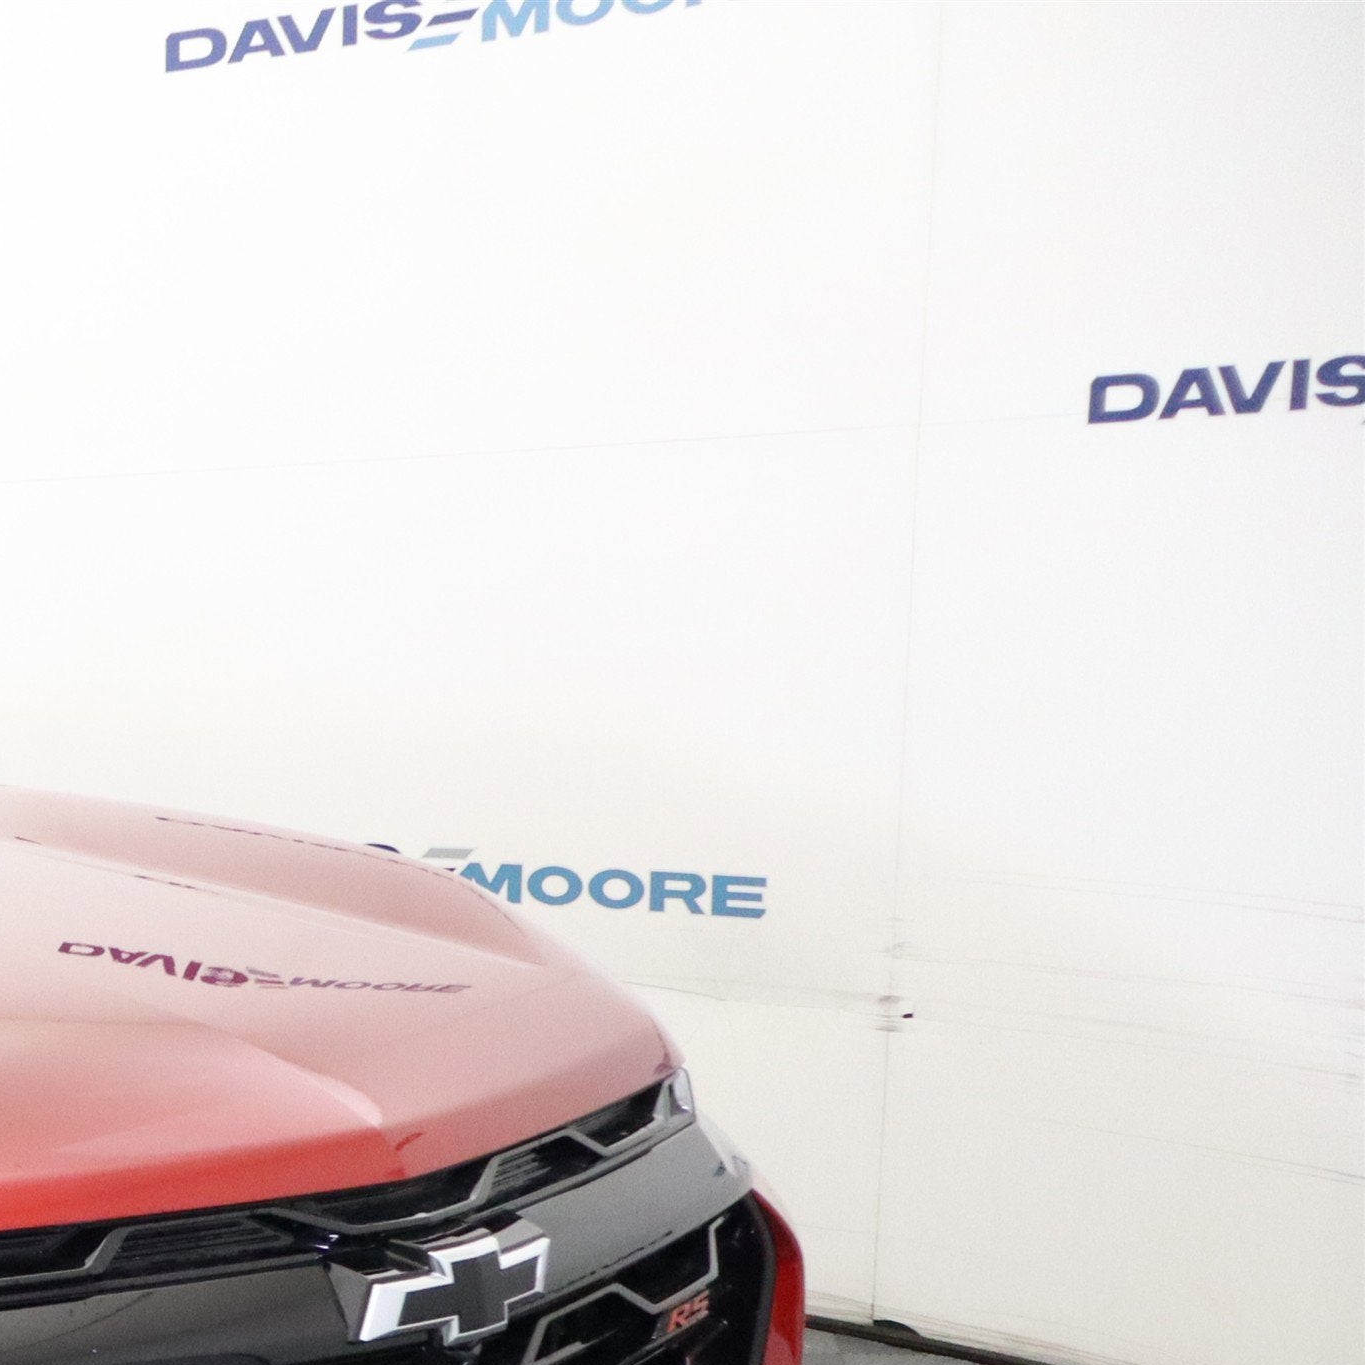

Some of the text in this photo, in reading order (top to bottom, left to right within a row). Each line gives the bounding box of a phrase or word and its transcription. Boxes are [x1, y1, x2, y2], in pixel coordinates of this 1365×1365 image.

[164, 0, 422, 73] DAVIS
[1087, 354, 1365, 425] DAVIS
[459, 861, 768, 919] MOORE
[666, 1289, 710, 1334] RS
